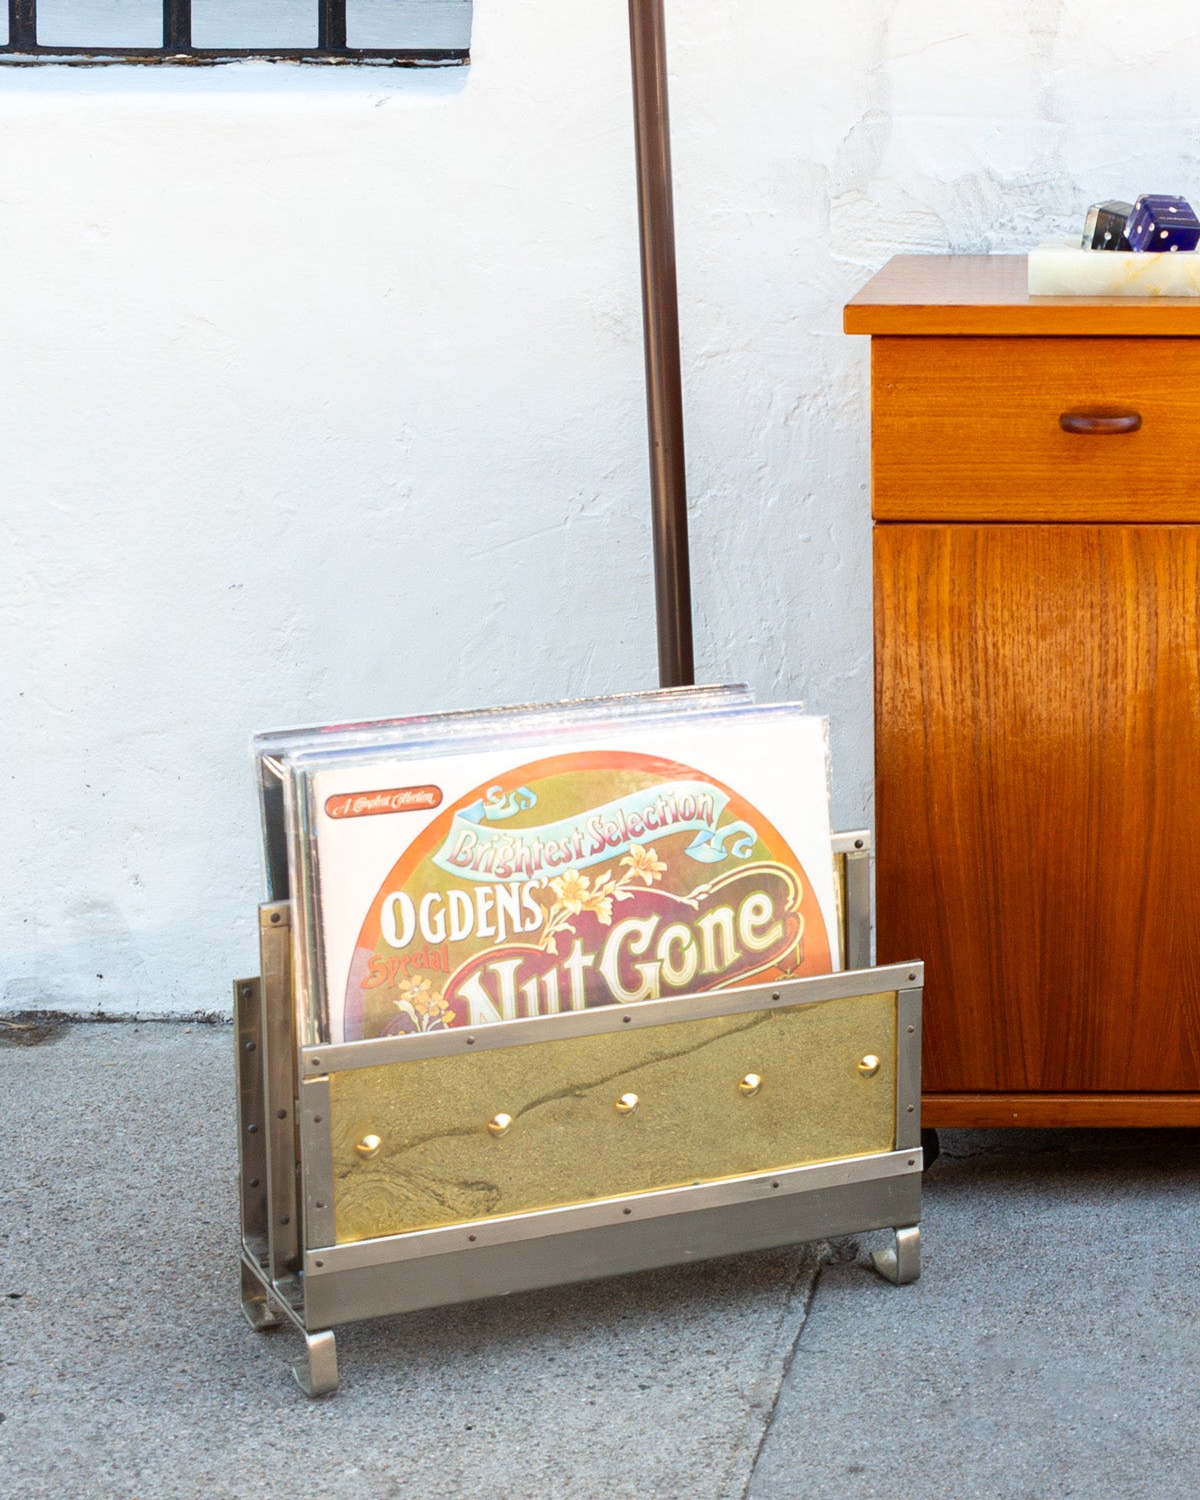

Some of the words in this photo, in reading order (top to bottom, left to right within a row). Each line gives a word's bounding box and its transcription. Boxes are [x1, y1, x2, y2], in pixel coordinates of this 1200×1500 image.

[332, 798, 352, 815] A
[391, 790, 436, 809] Collection
[447, 826, 587, 879] Brightest
[588, 789, 714, 856] Selection
[381, 877, 551, 948] OGDENS'
[361, 944, 450, 989] Special
